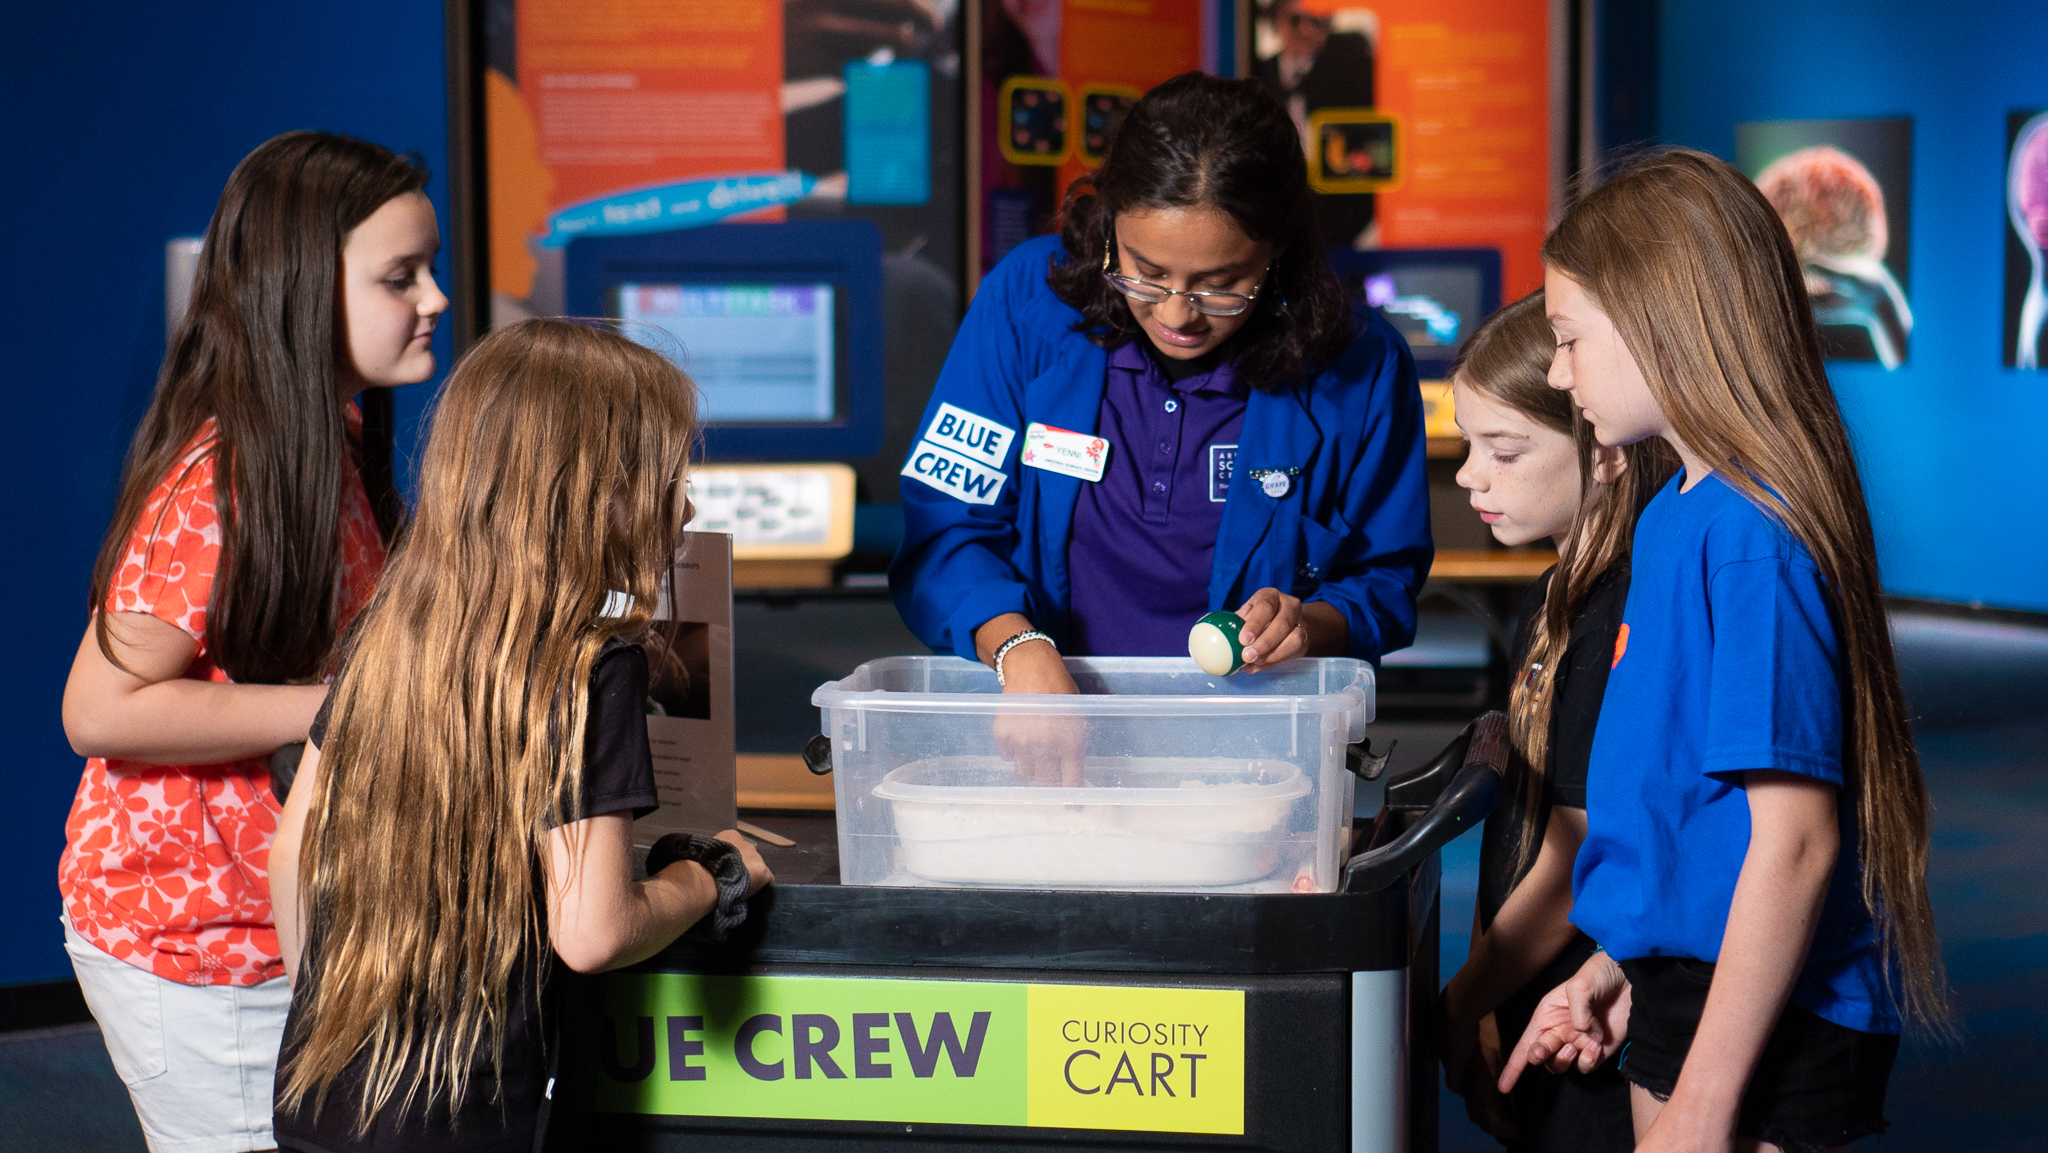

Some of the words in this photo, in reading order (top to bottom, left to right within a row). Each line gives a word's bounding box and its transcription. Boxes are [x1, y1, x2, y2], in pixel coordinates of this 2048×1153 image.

[936, 413, 1002, 456] BLUE
[1057, 446, 1082, 459] YENNI
[914, 452, 998, 499] CREW
[1265, 481, 1286, 490] GRAPE
[733, 1011, 992, 1082] CREW
[1061, 1019, 1209, 1047] CURIOSITY
[1063, 1048, 1208, 1098] CART
